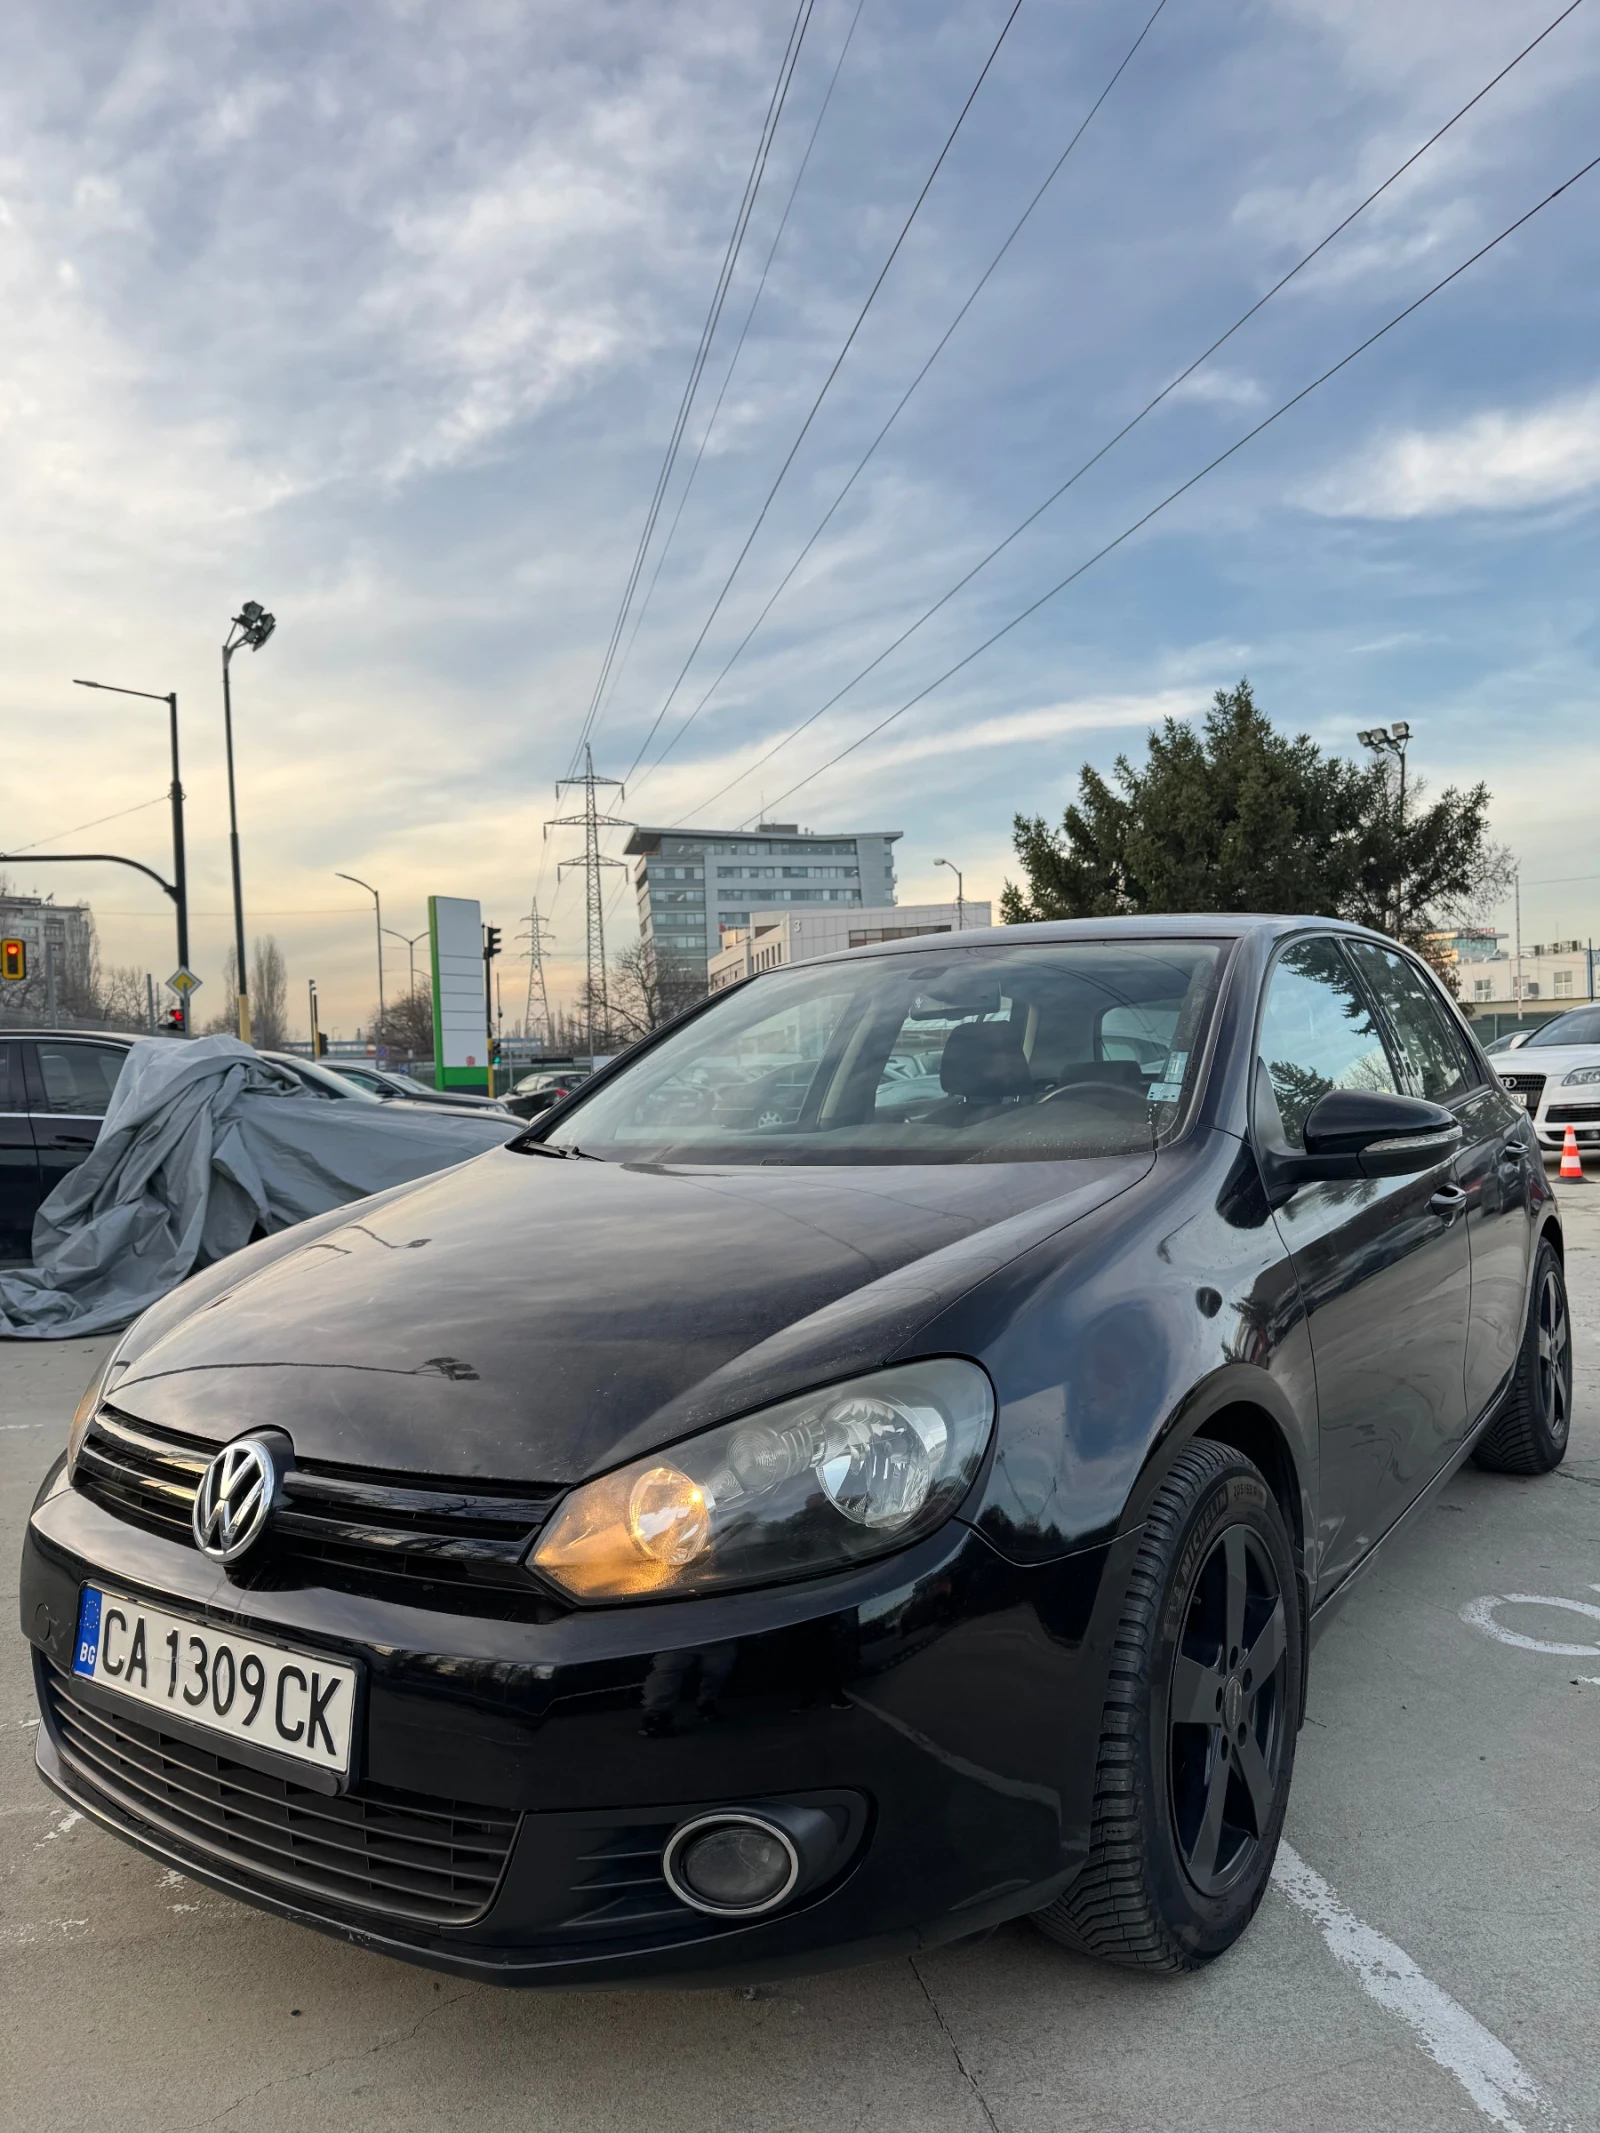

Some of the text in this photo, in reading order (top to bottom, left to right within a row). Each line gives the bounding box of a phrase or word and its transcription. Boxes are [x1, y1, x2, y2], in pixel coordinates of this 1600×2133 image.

[793, 920, 802, 932] 3
[1180, 1488, 1228, 1583] MICHELIN
[80, 1641, 96, 1665] BG
[102, 1606, 342, 1756] CA 1309 CK
